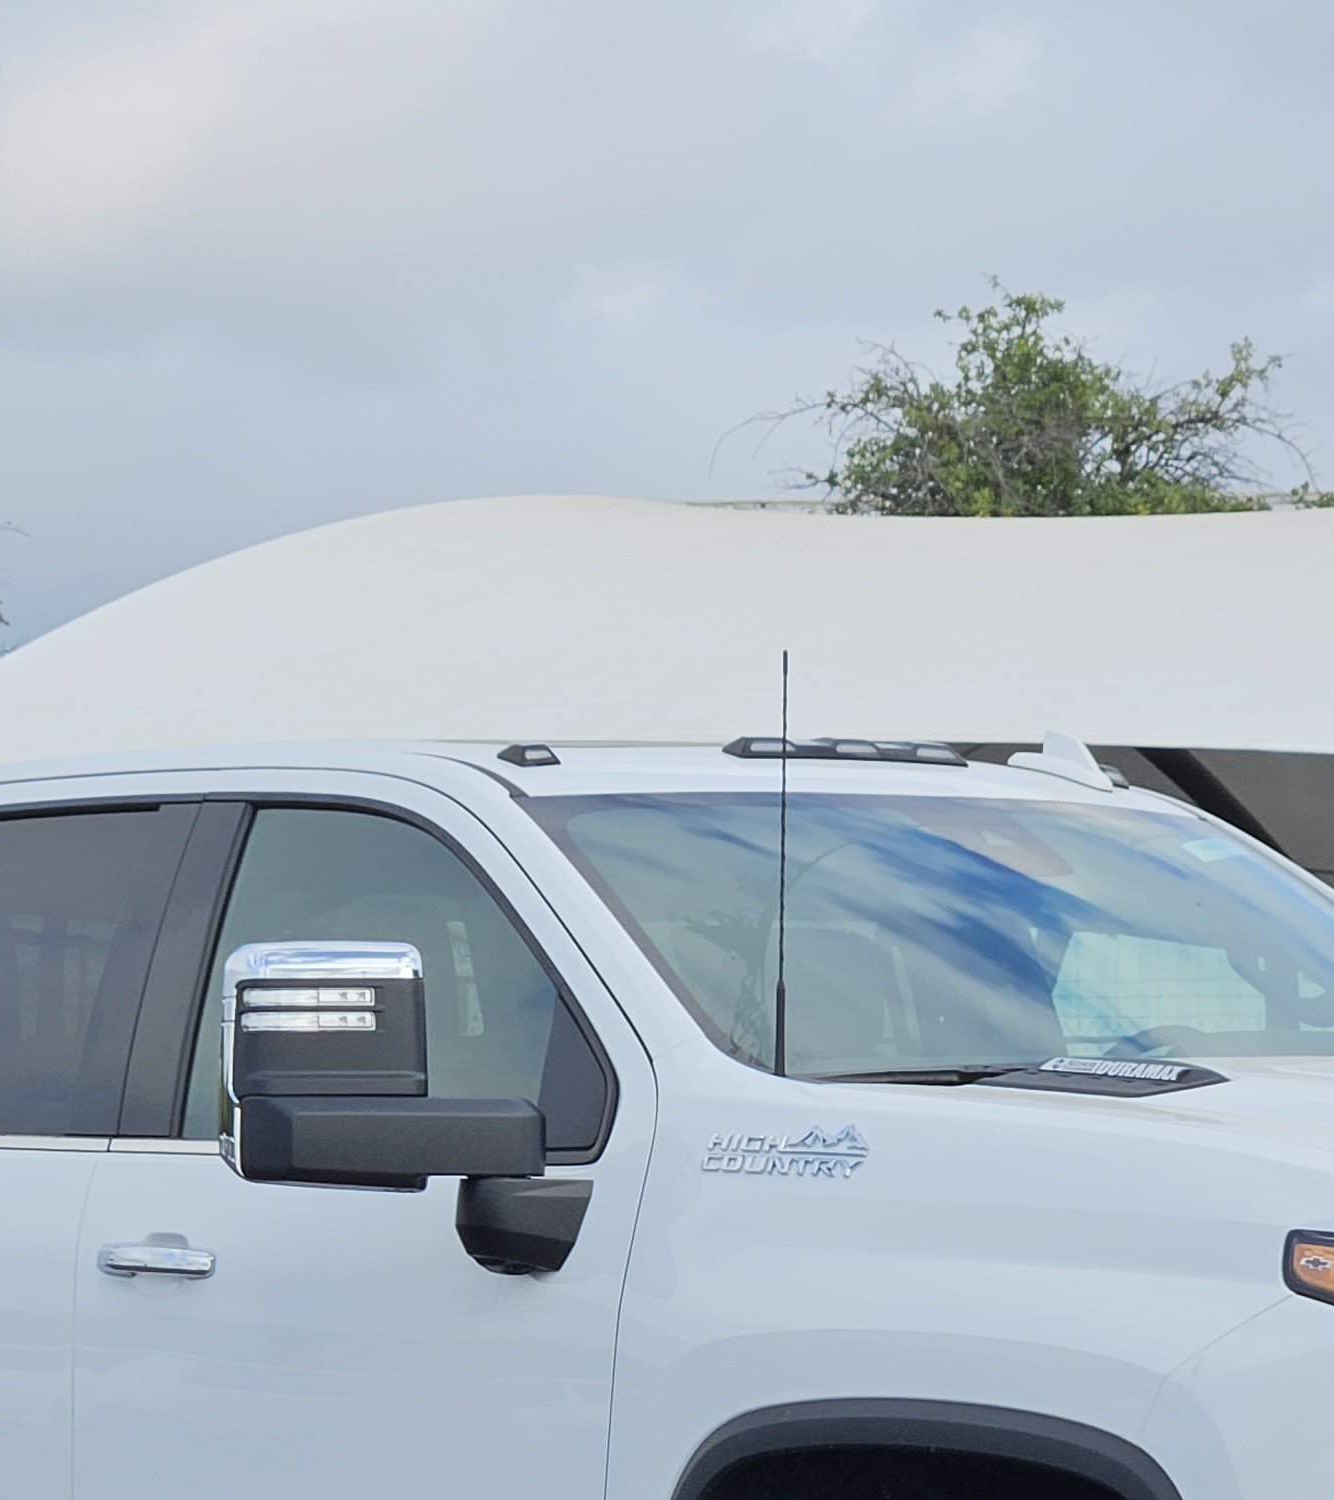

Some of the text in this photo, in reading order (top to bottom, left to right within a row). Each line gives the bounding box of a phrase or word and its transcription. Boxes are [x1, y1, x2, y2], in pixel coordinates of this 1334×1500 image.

[1095, 1061, 1188, 1081] DURAMAX
[707, 1133, 789, 1152] HIGH
[701, 1153, 864, 1178] COUNTRY
